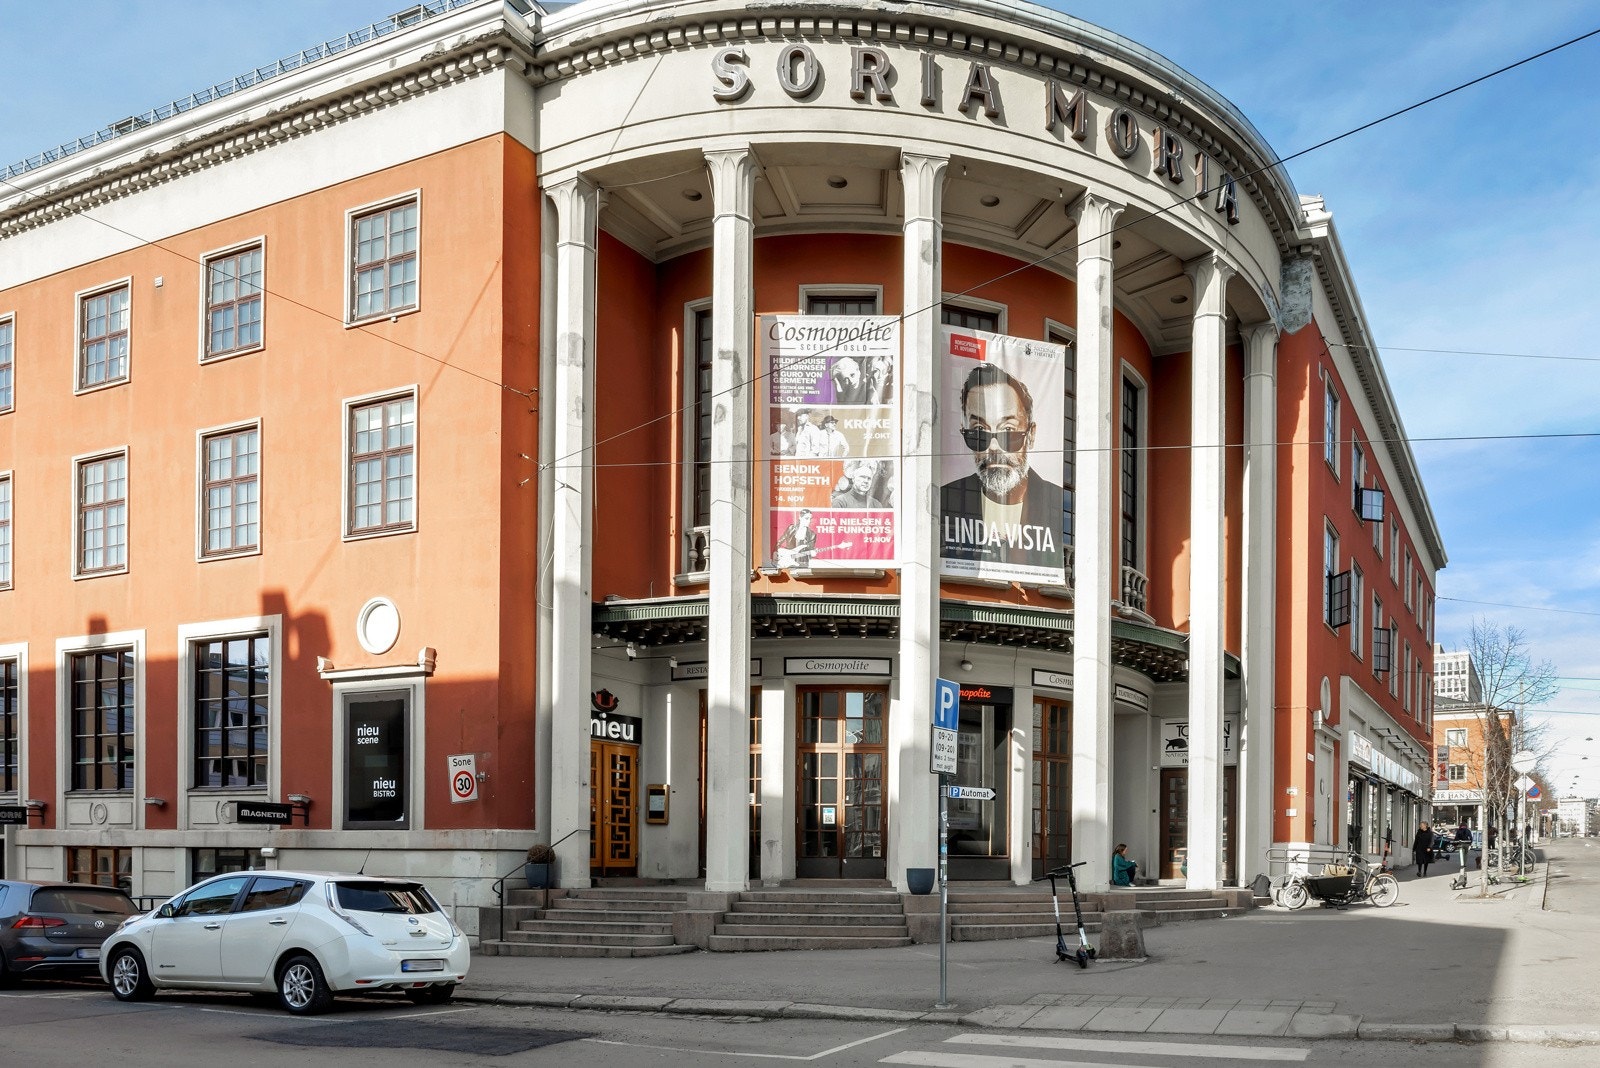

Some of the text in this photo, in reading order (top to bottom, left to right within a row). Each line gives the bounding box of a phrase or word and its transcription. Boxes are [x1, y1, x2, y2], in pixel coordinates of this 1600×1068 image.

[712, 44, 1239, 223] SORIA MORIA
[769, 319, 892, 350] Cosmopolite
[844, 419, 891, 429] KROKE
[774, 464, 820, 474] BENDIK
[774, 476, 830, 486] HOFSETH
[820, 517, 837, 526] IDA
[840, 517, 881, 526] NIELSEN
[816, 525, 891, 534] THE FUNKBOTS
[944, 515, 1056, 553] LINDA VISTA
[806, 660, 870, 673] Cosmopolite
[940, 686, 954, 722] P
[357, 724, 379, 736] nieu
[591, 712, 634, 741] nieu
[357, 736, 379, 745] scene
[452, 758, 471, 767] Sone
[373, 777, 395, 789] nieu
[457, 777, 471, 791] 30
[952, 788, 989, 798] P Automat
[241, 809, 287, 819] MAGNETEN
